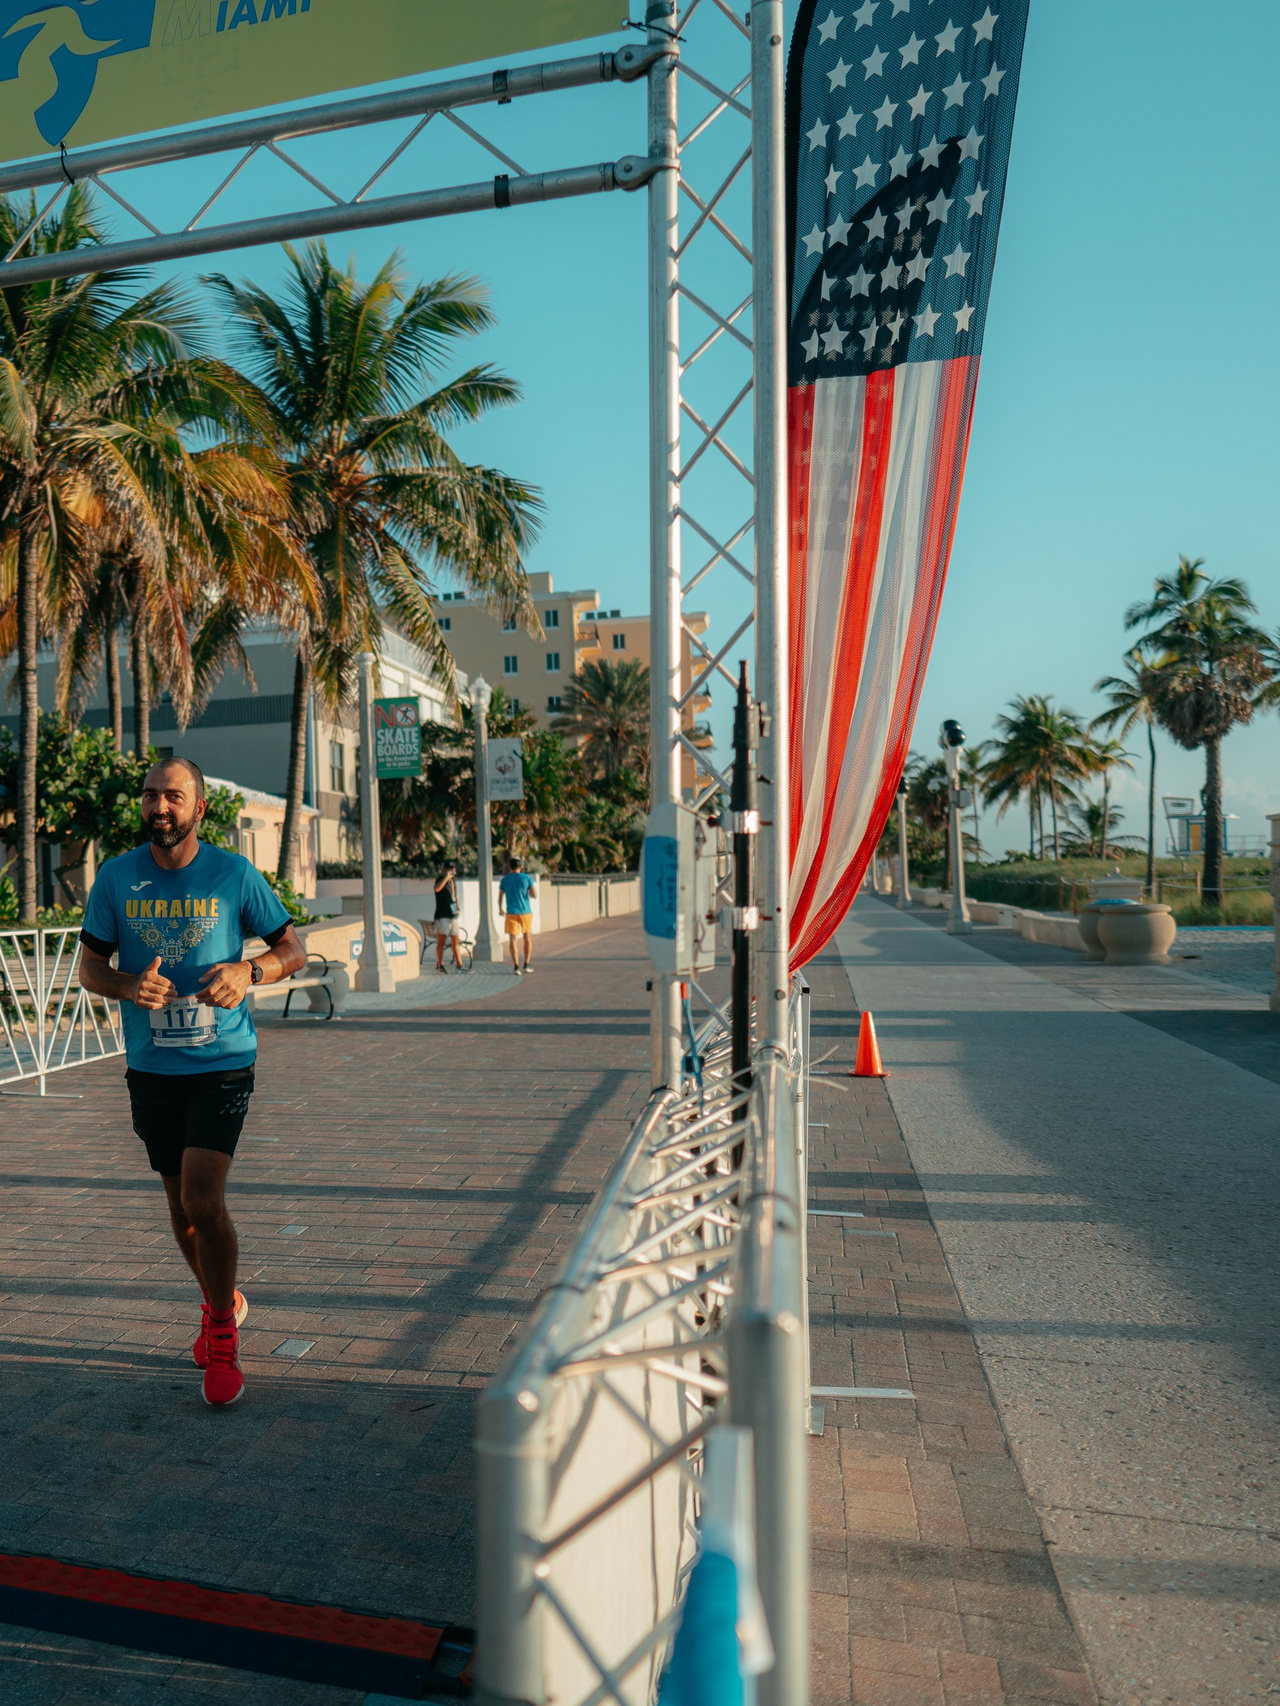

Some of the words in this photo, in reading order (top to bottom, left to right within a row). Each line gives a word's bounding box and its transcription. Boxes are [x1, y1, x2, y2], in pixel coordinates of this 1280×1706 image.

[377, 727, 419, 745] SKATE
[377, 743, 419, 757] BOARDS
[126, 894, 219, 918] UKRAINE
[163, 1007, 198, 1027] 117
